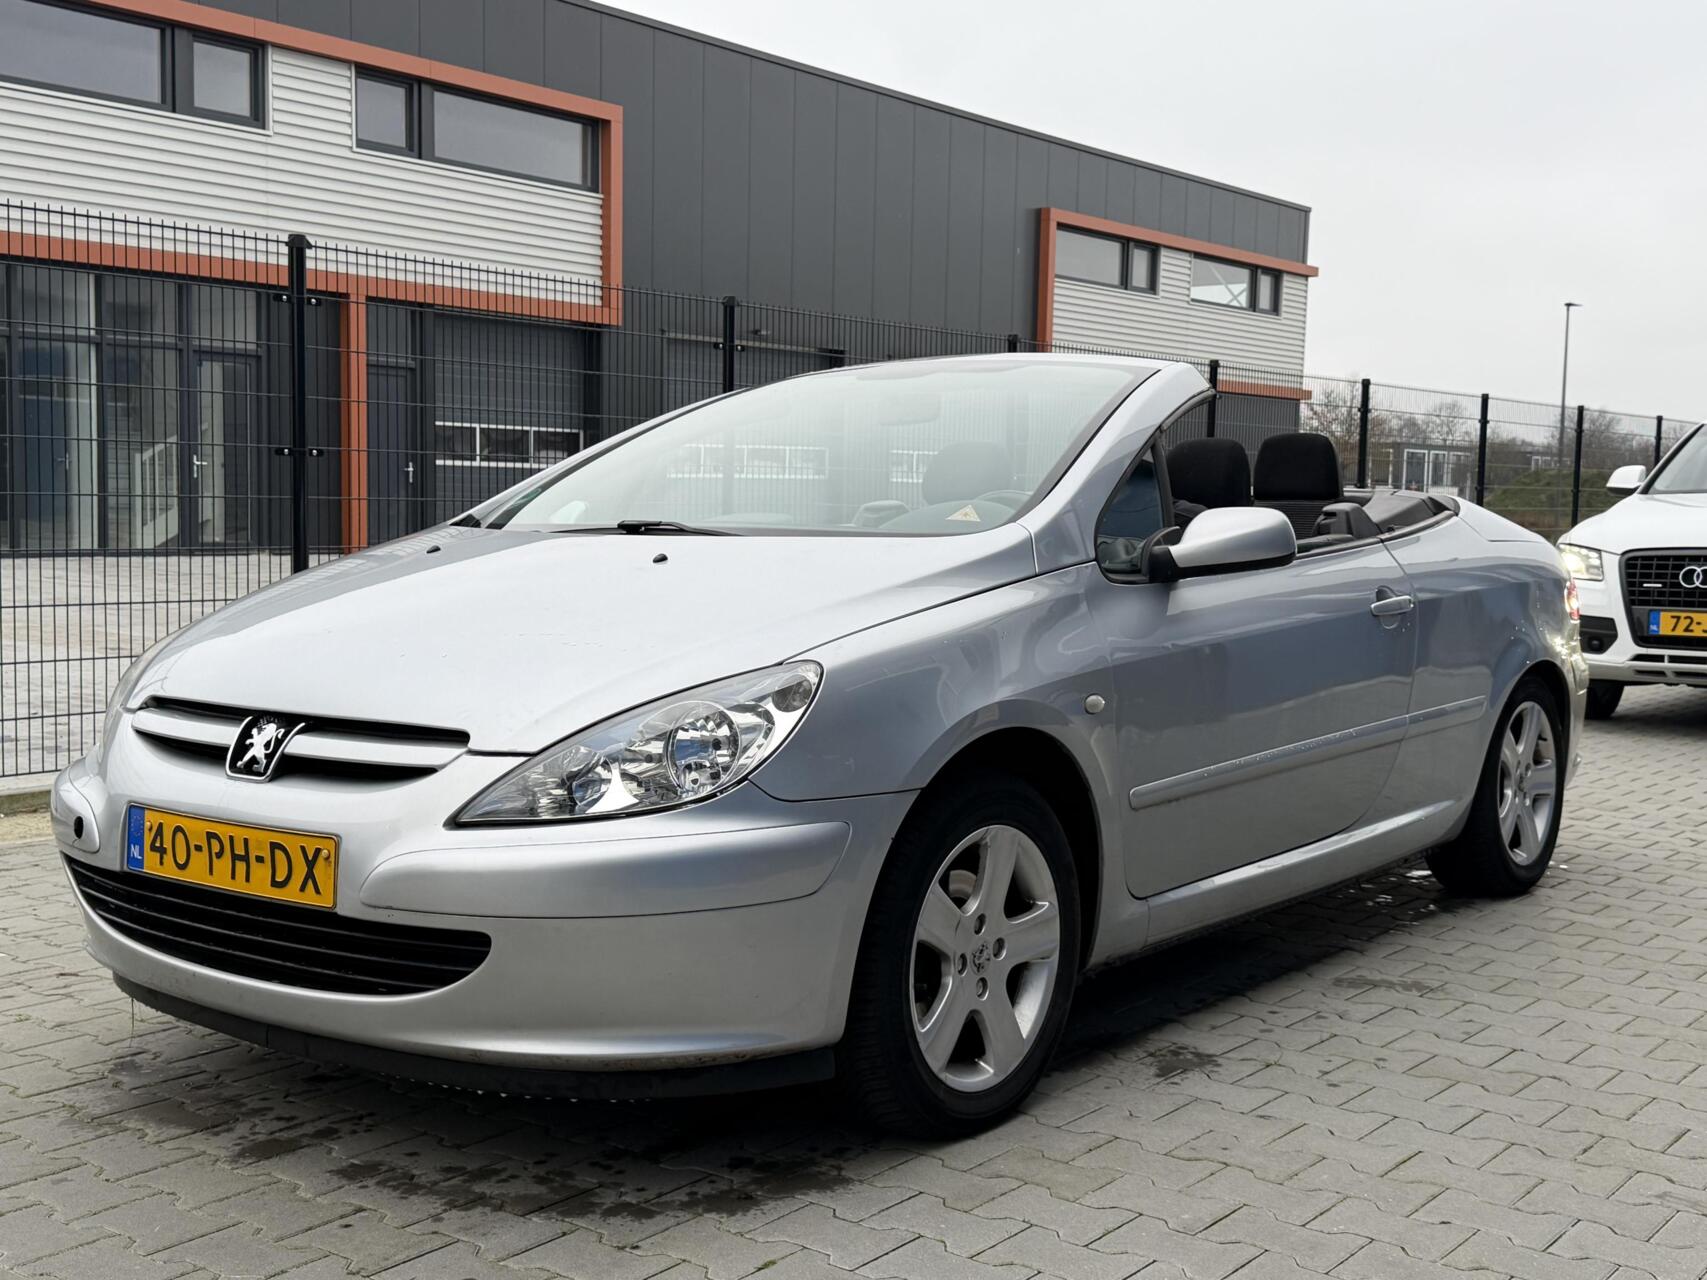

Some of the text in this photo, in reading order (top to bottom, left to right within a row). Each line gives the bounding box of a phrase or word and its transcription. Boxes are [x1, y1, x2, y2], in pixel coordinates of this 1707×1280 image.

[1670, 615, 1707, 633] 72-
[130, 844, 142, 860] NL
[149, 821, 322, 896] 40-PH-DX
